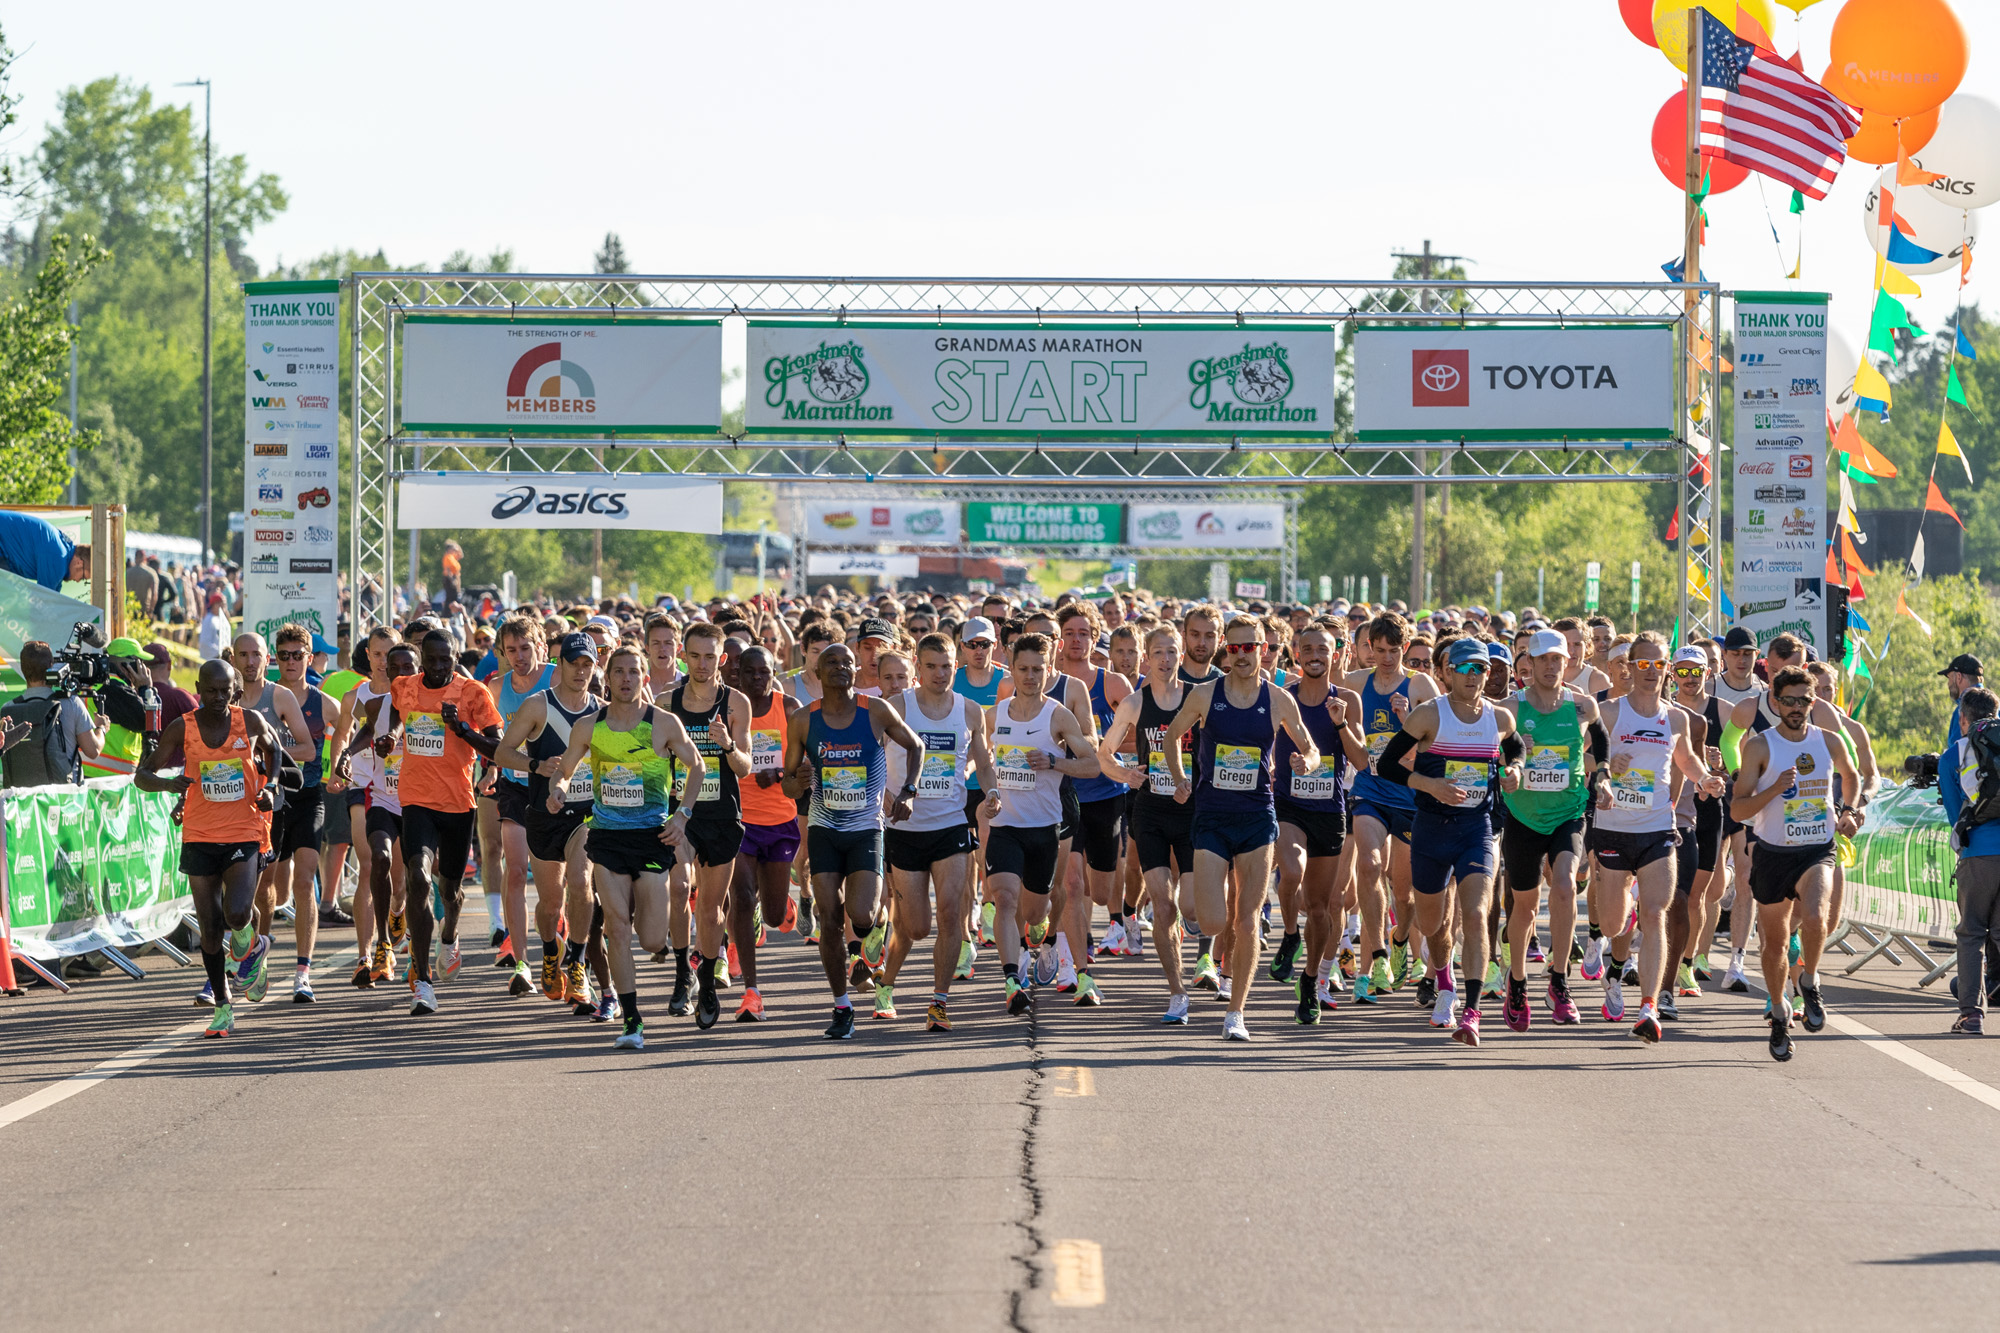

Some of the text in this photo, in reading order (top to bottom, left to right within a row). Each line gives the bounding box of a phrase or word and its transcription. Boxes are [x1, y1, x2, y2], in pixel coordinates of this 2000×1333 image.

[1869, 69, 1940, 84] MEMBERS
[250, 302, 334, 317] THANK YOU
[1739, 313, 1824, 328] THANK YOU
[935, 338, 1142, 352] GRANDMAS MARATHON
[1483, 365, 1618, 390] TOYOTA
[932, 358, 1147, 423] START
[300, 401, 328, 409] Hearth
[507, 398, 596, 413] MEMBERS
[782, 400, 893, 420] Marathon
[1206, 401, 1317, 422] Marathon
[296, 421, 322, 429] Tribune
[255, 446, 286, 454] JAMAR
[991, 506, 1099, 522] WELCOME TO
[304, 529, 332, 537] GRAND
[984, 524, 1105, 540] TWO HARBORS
[1777, 541, 1815, 551] DASANI
[1740, 584, 1788, 592] maurices
[1752, 600, 1784, 611] Michelina's
[407, 734, 442, 749] Ondoro
[1620, 734, 1669, 746] playmakers
[753, 754, 775, 765] erer
[828, 750, 862, 758] DEPOT
[997, 768, 1035, 782] Jermann
[1220, 769, 1252, 784] Gregg
[1529, 771, 1565, 783] Carter
[203, 781, 244, 794] M Rotich
[919, 778, 950, 789] Lewis
[1294, 779, 1331, 793] Bogina
[602, 785, 643, 799] Albertson
[824, 790, 865, 802] Mokono
[1617, 790, 1646, 804] Crain
[1787, 822, 1826, 836] Cowart
